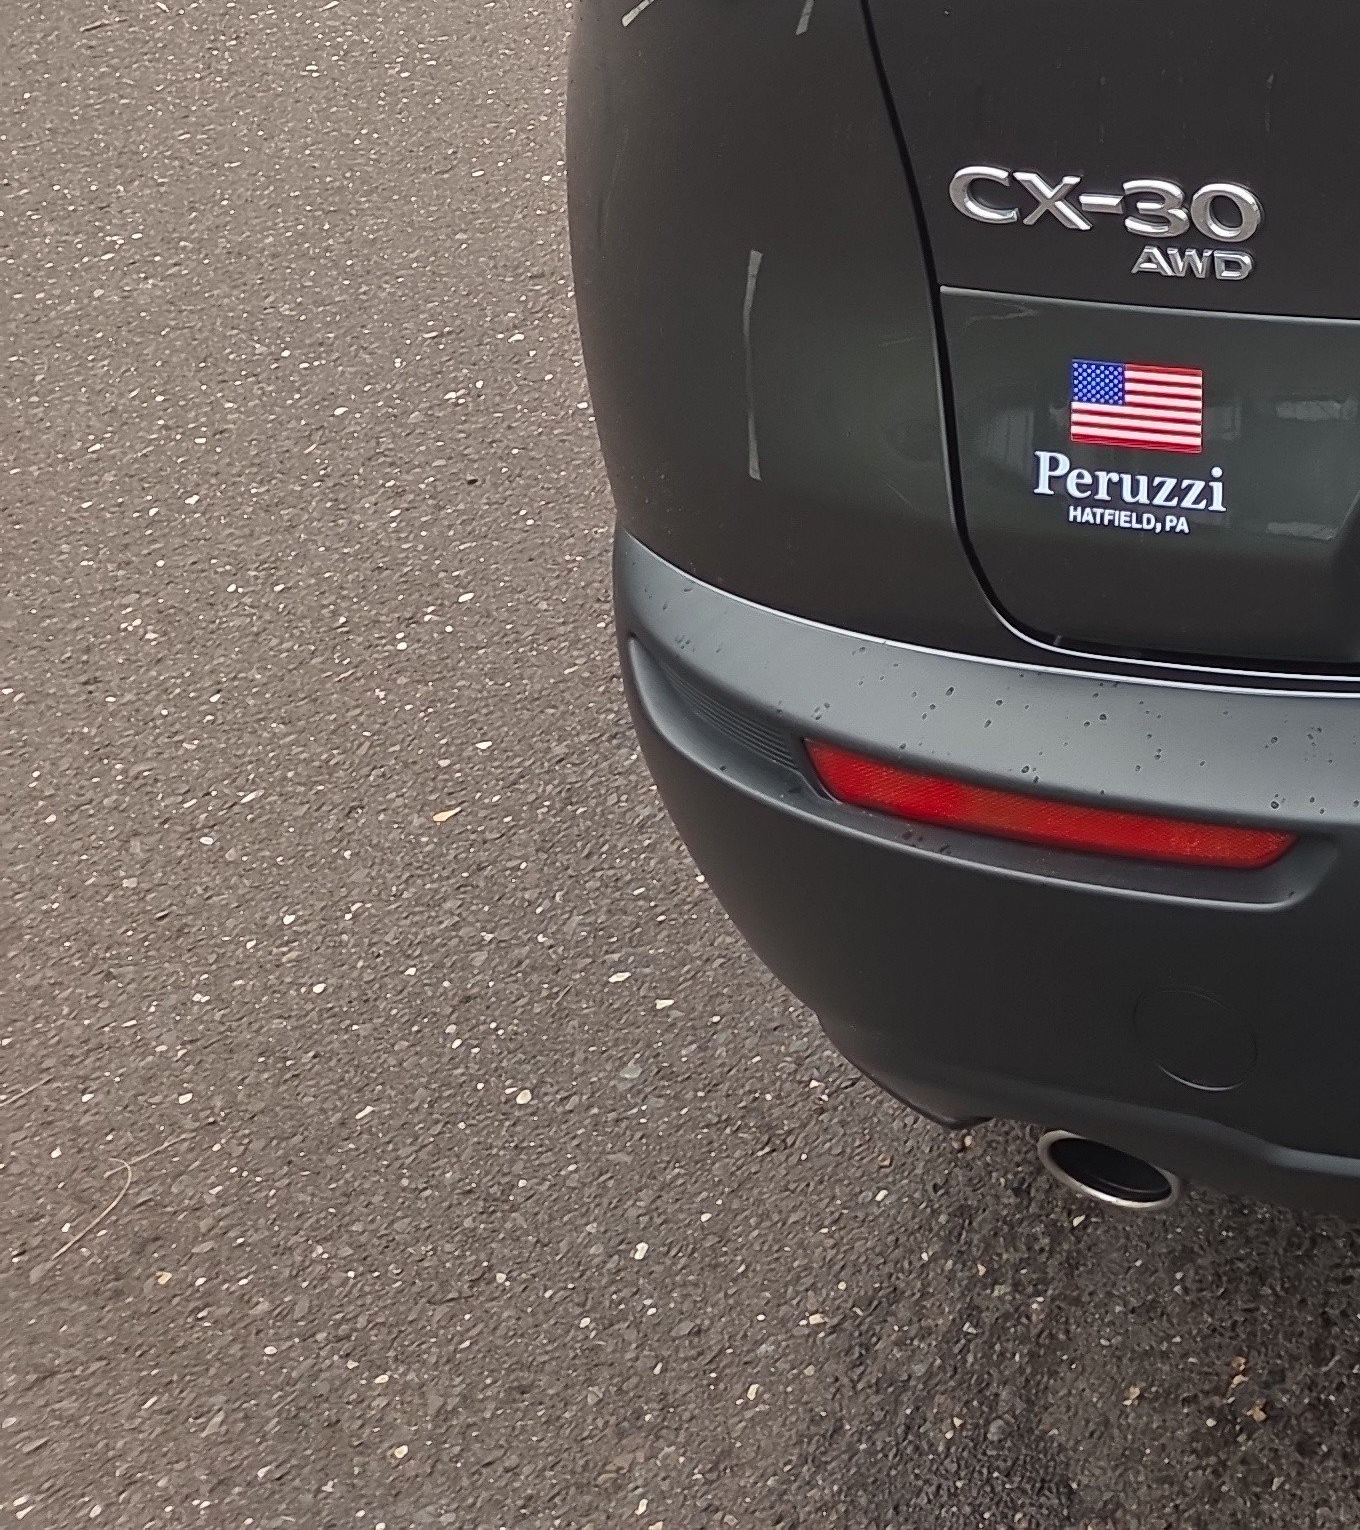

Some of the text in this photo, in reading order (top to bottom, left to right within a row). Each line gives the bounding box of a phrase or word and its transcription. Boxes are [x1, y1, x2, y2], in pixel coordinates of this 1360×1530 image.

[949, 165, 1263, 243] CX-30
[1131, 245, 1253, 280] AWD
[1034, 451, 1227, 512] Peruzzi
[1068, 505, 1190, 534] HATFIELD, PA
